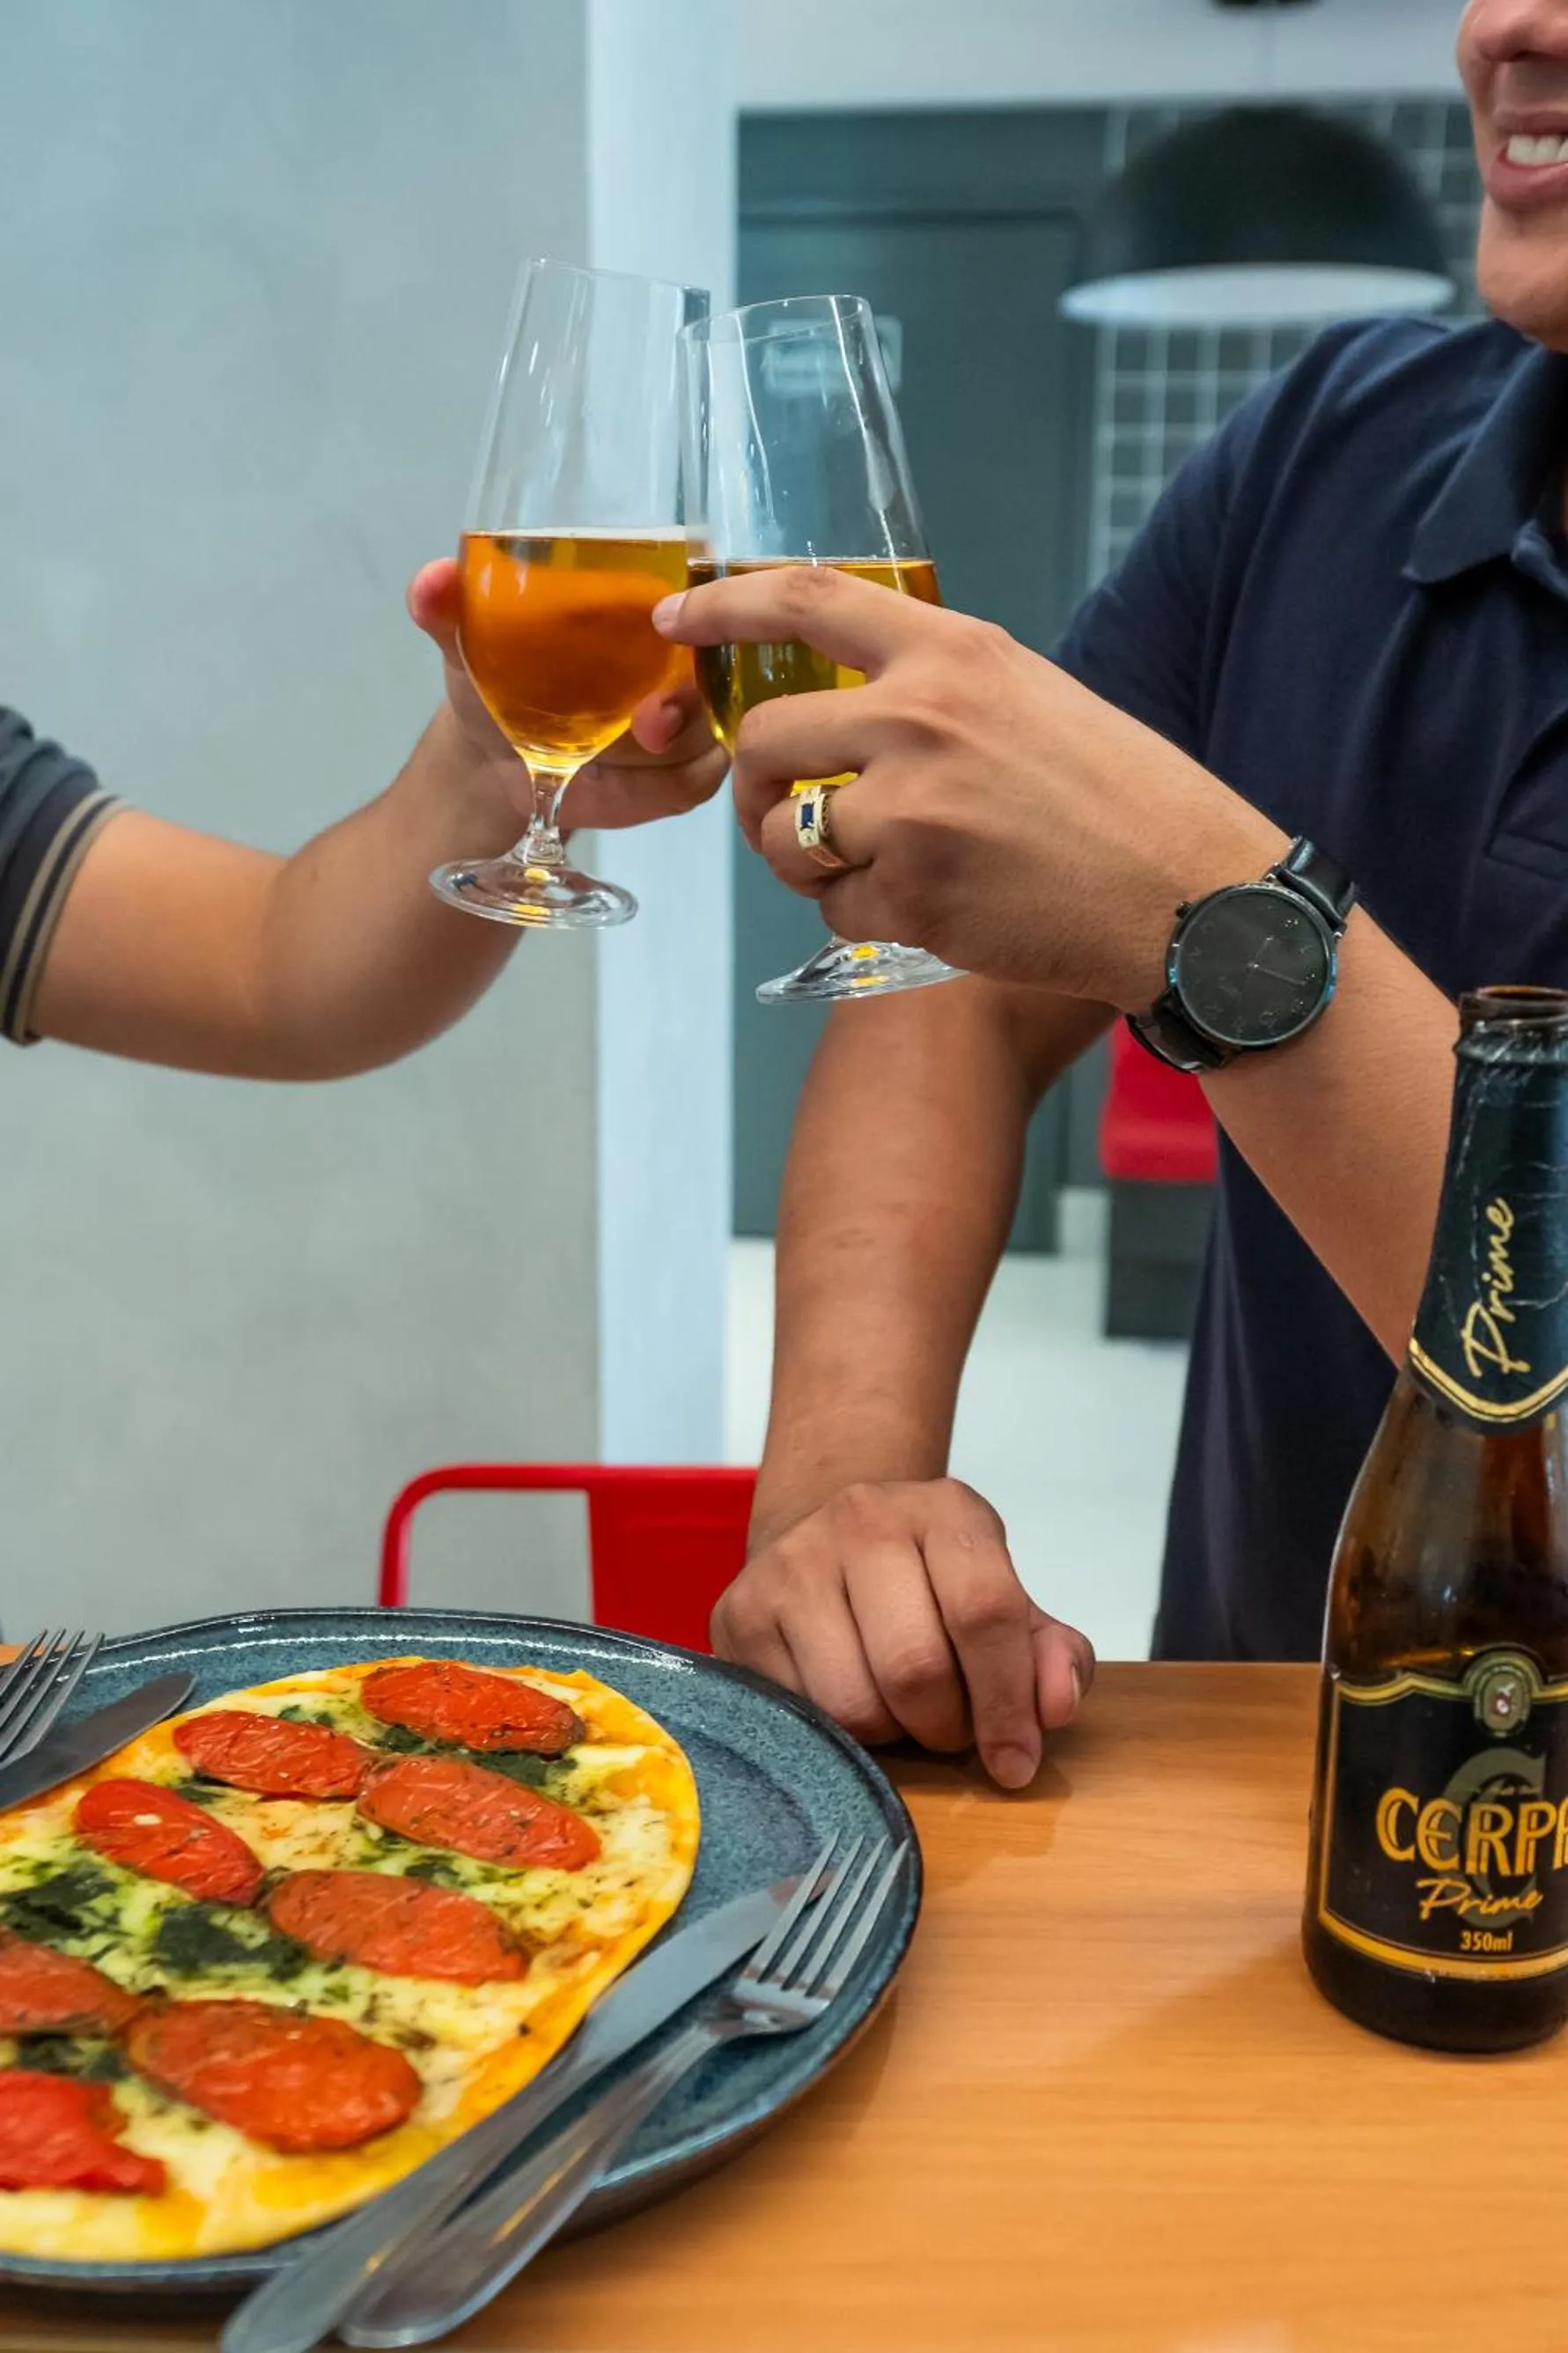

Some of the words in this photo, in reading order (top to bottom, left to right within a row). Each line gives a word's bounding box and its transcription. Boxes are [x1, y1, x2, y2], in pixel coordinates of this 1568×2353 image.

[1461, 1198, 1531, 1377] Prime
[1416, 1877, 1544, 1921] Prime
[1460, 1929, 1513, 1952] 350ml
